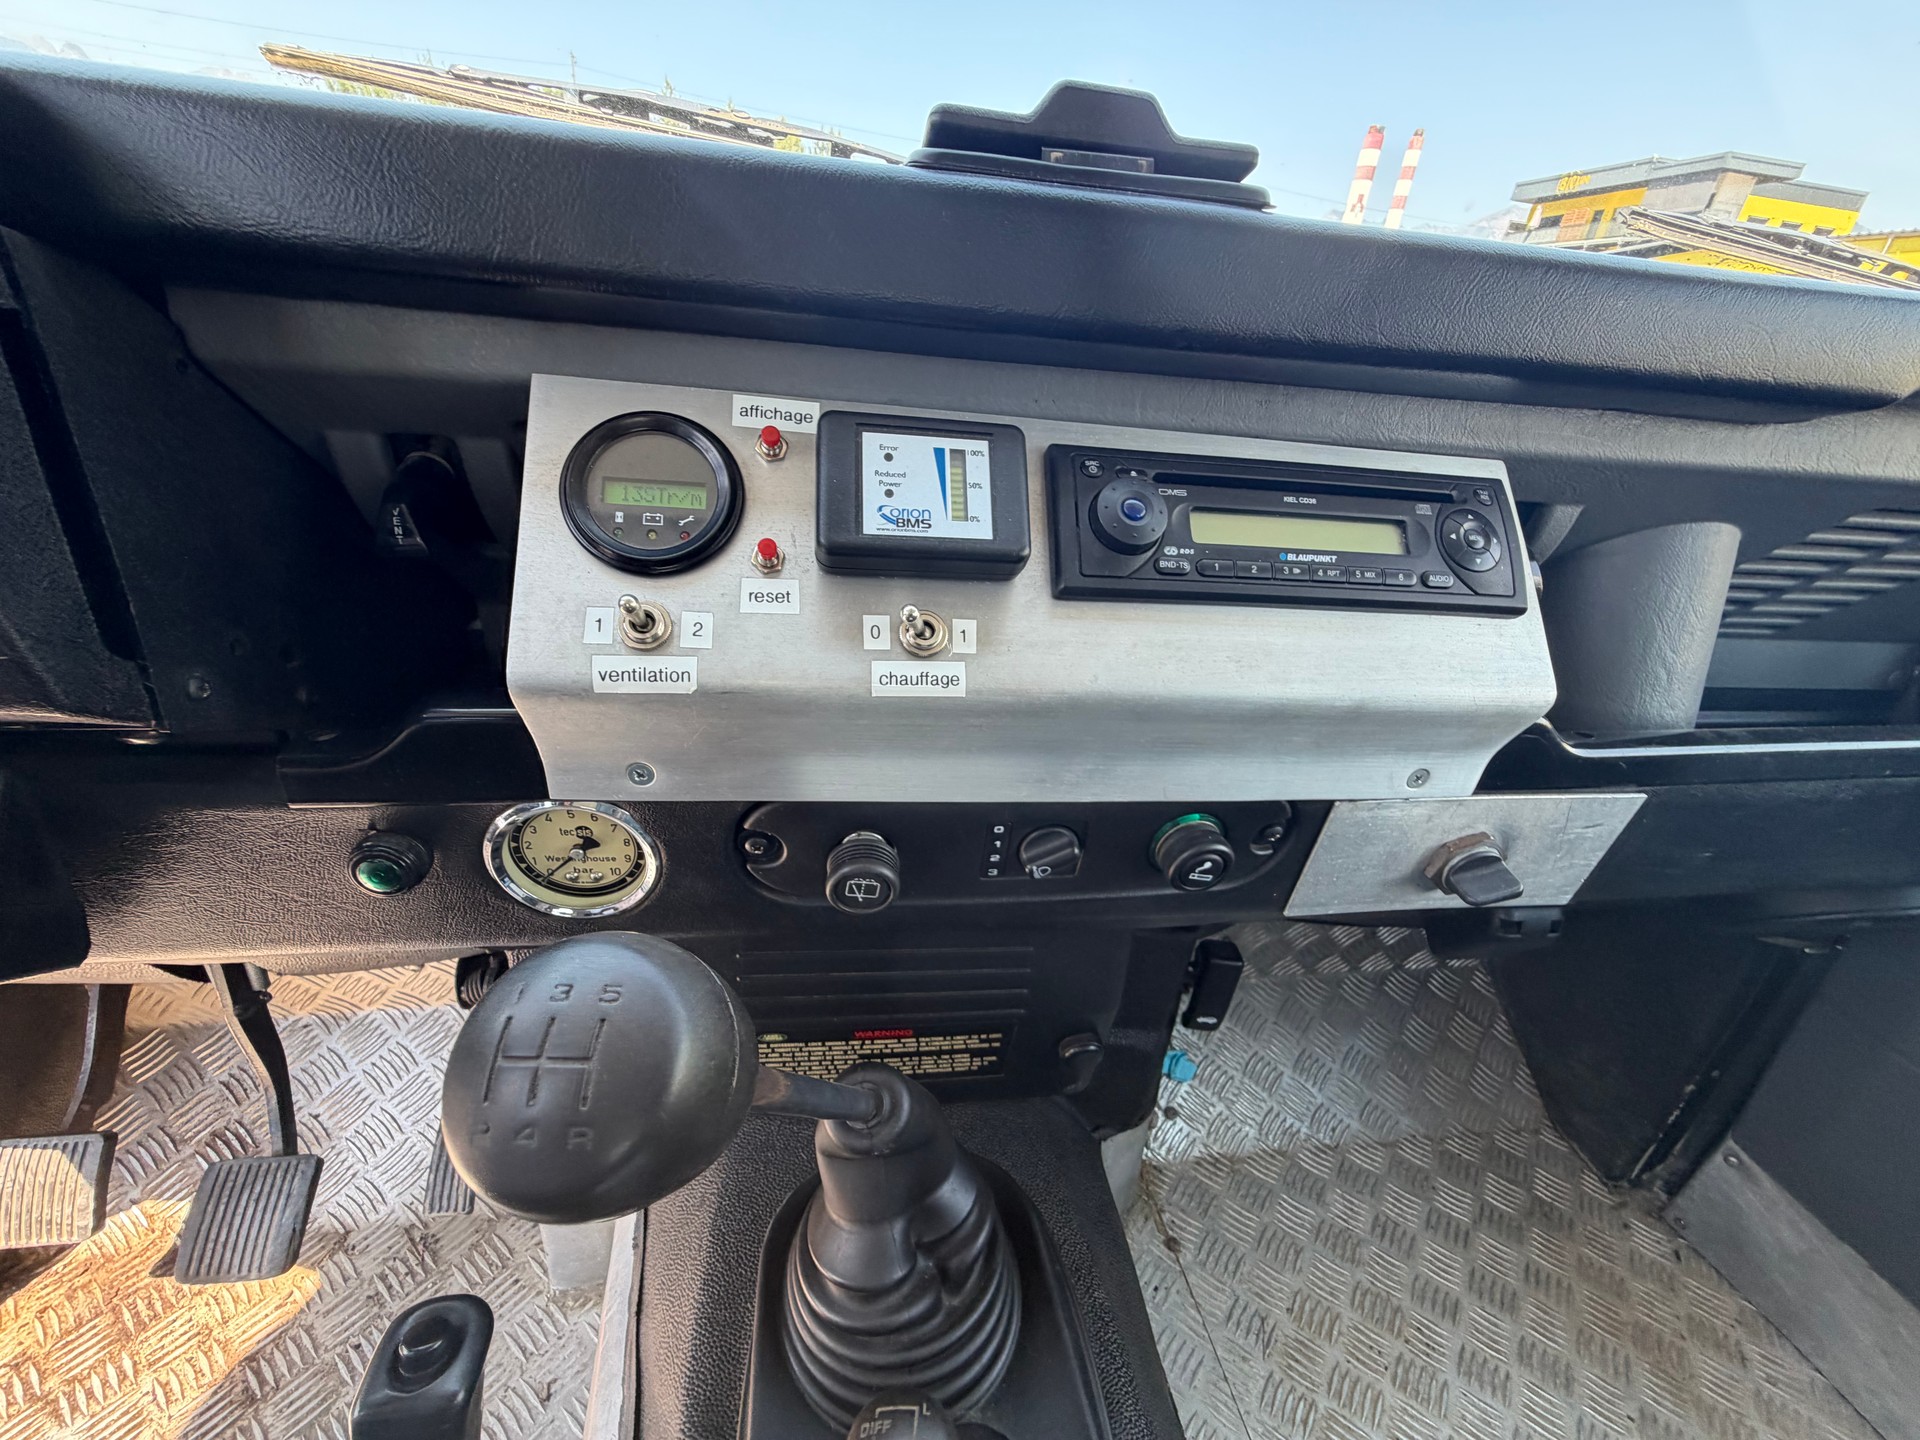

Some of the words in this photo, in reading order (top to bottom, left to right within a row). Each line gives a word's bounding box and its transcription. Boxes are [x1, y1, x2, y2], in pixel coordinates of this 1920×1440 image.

[739, 404, 814, 425] affichage
[879, 443, 899, 452] Error
[967, 449, 985, 458] 100%
[874, 469, 906, 479] Reduced
[878, 480, 903, 488] Power
[968, 482, 983, 490] 50%
[889, 507, 932, 520] orion
[896, 517, 932, 530] BMS
[969, 515, 981, 523] 0%
[392, 506, 404, 545] VENT
[1287, 553, 1338, 563] BLAUPUNKT
[1214, 563, 1219, 571] 1
[1356, 570, 1361, 578] 5
[1428, 574, 1450, 583] AUDIO
[748, 589, 791, 604] reset
[594, 617, 602, 633] 1
[691, 621, 704, 638] 2
[870, 624, 881, 640] 0
[959, 629, 967, 643] 1
[598, 666, 692, 683] ventilation
[878, 671, 960, 689] chauffage
[545, 814, 552, 822] 4
[567, 810, 575, 818] 5
[591, 813, 598, 821] 6
[530, 825, 537, 834] 3
[559, 826, 592, 838] tecsis
[611, 824, 617, 832] 7
[524, 841, 532, 849] 2
[623, 838, 630, 846] 8
[531, 857, 538, 866] 1
[624, 854, 631, 863] 9
[573, 866, 594, 874] bar
[610, 867, 621, 876] 10
[514, 981, 526, 1004] 1
[549, 982, 575, 1003] 3
[598, 983, 624, 1005] 5
[853, 1028, 914, 1039] WARNING
[513, 1125, 538, 1148] 4
[566, 1125, 594, 1151] R
[923, 1403, 931, 1415] L
[860, 1420, 891, 1438] DIFF
